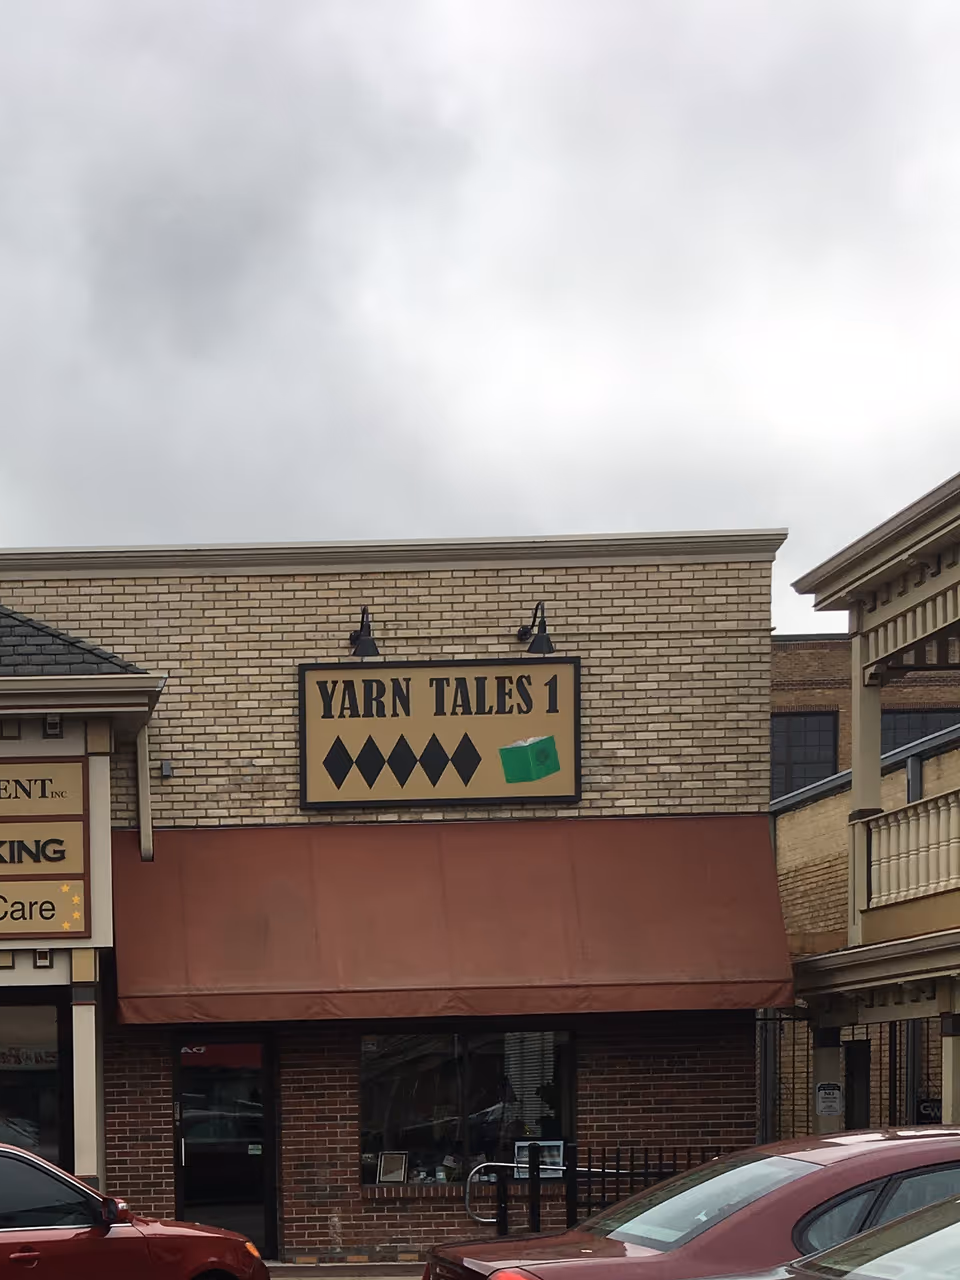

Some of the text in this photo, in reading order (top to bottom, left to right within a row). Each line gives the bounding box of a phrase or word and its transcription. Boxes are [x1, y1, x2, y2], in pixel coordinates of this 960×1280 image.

[316, 674, 559, 719] YARN TALES 1
